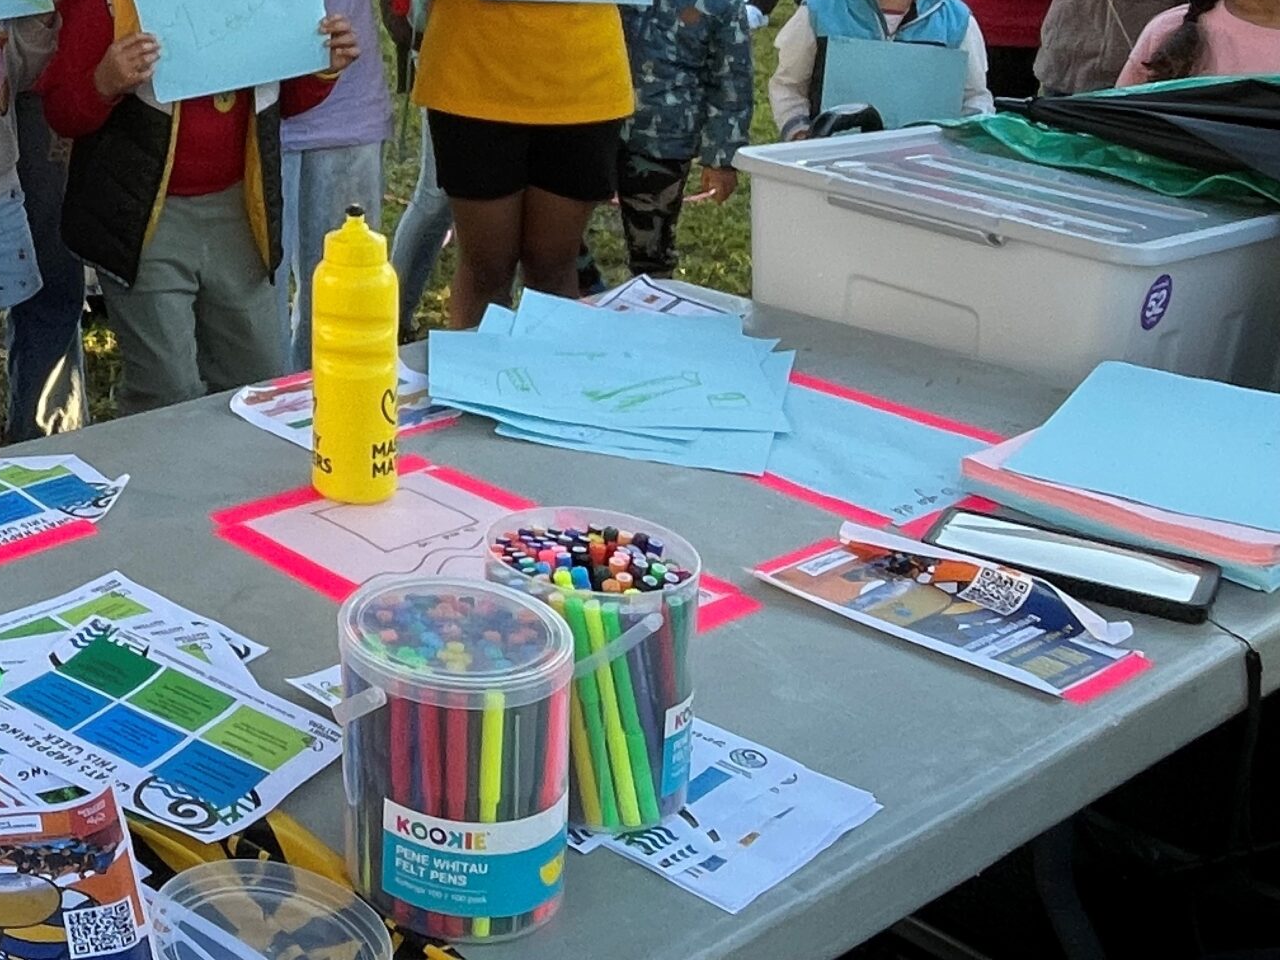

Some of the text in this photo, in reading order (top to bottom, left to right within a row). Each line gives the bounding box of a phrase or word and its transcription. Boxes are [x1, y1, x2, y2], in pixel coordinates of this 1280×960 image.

[42, 732, 118, 774] THIS WEEK
[77, 766, 131, 792] WATS
[396, 815, 487, 850] KOOKIE
[395, 845, 488, 875] PENE WHITAU
[395, 857, 467, 886] FELT PENS
